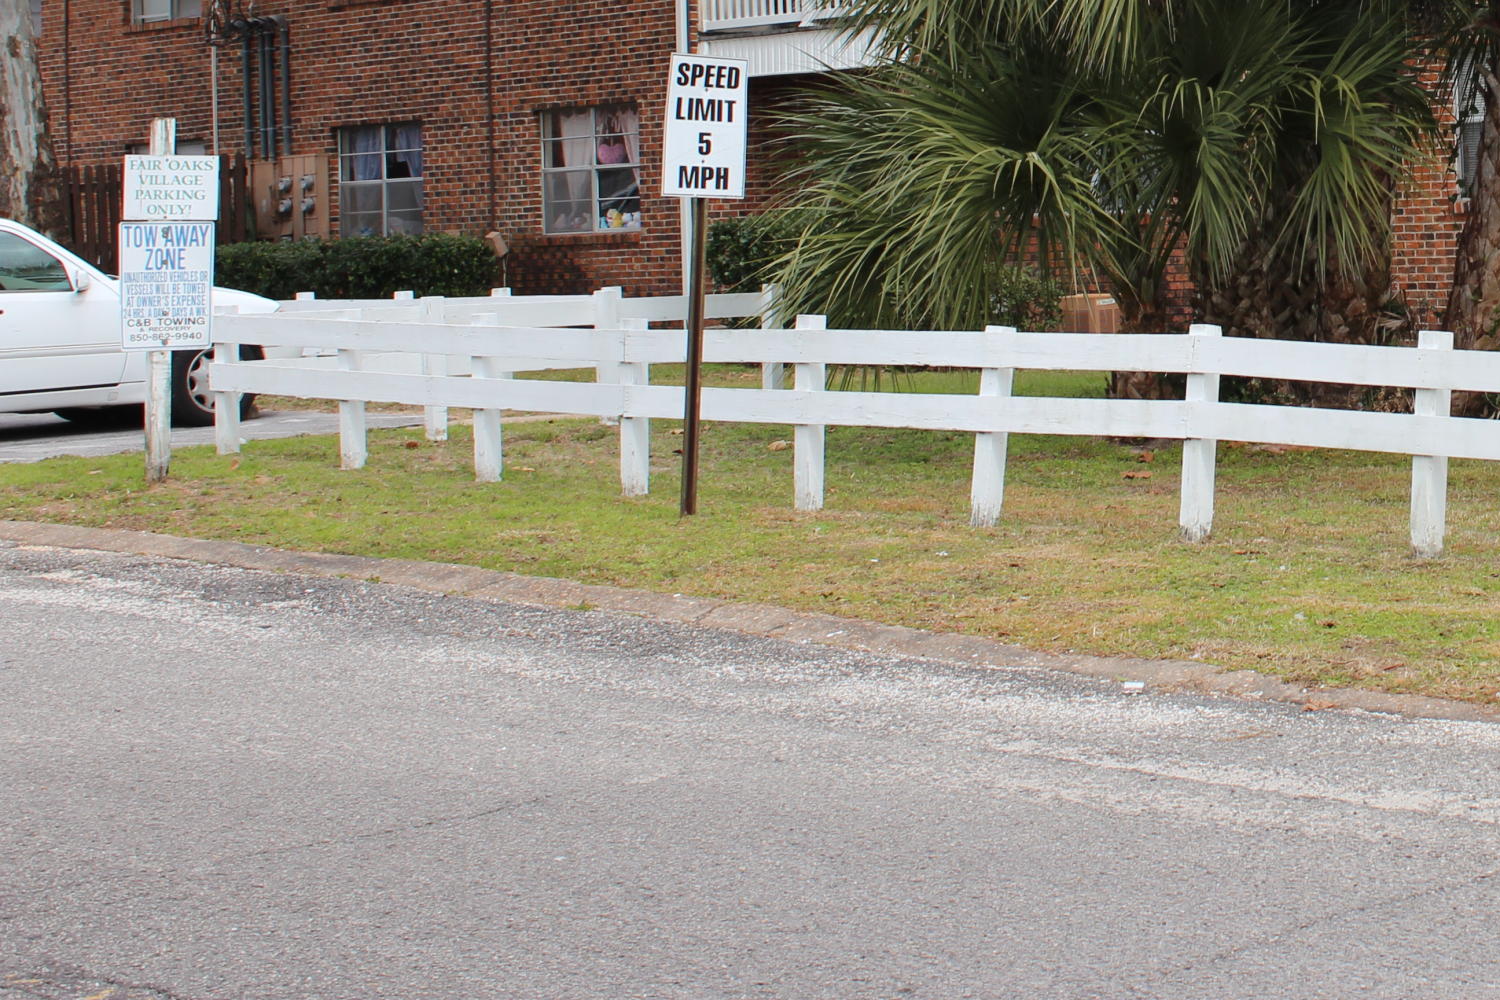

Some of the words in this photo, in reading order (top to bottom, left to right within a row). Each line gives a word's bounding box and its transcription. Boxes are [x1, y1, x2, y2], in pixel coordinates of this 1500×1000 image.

[676, 62, 741, 90] SPEED
[675, 96, 737, 123] LIMIT
[697, 132, 712, 156] 5
[130, 159, 162, 171] FAIR
[168, 160, 214, 171] OAKS
[138, 174, 204, 186] VILLAGE
[678, 165, 730, 190] MPH
[135, 189, 206, 201] PARKING
[146, 204, 192, 215] ONLY!
[124, 225, 158, 248] TOW
[164, 225, 210, 247] AWAY
[144, 248, 187, 270] ZONE
[123, 271, 168, 283] UNAUTHORIZED
[169, 271, 199, 282] VEHICLES
[200, 270, 209, 282] OR
[126, 283, 154, 295] VESSELS
[155, 283, 170, 295] WILL
[172, 283, 180, 294] BE
[183, 283, 206, 294] TOWED
[126, 295, 134, 307] AT
[136, 295, 169, 307] OWNER'S
[171, 295, 206, 306] EXPENSE
[172, 307, 188, 317] DAYS
[127, 318, 152, 327] C&B
[157, 317, 206, 326] TOWING
